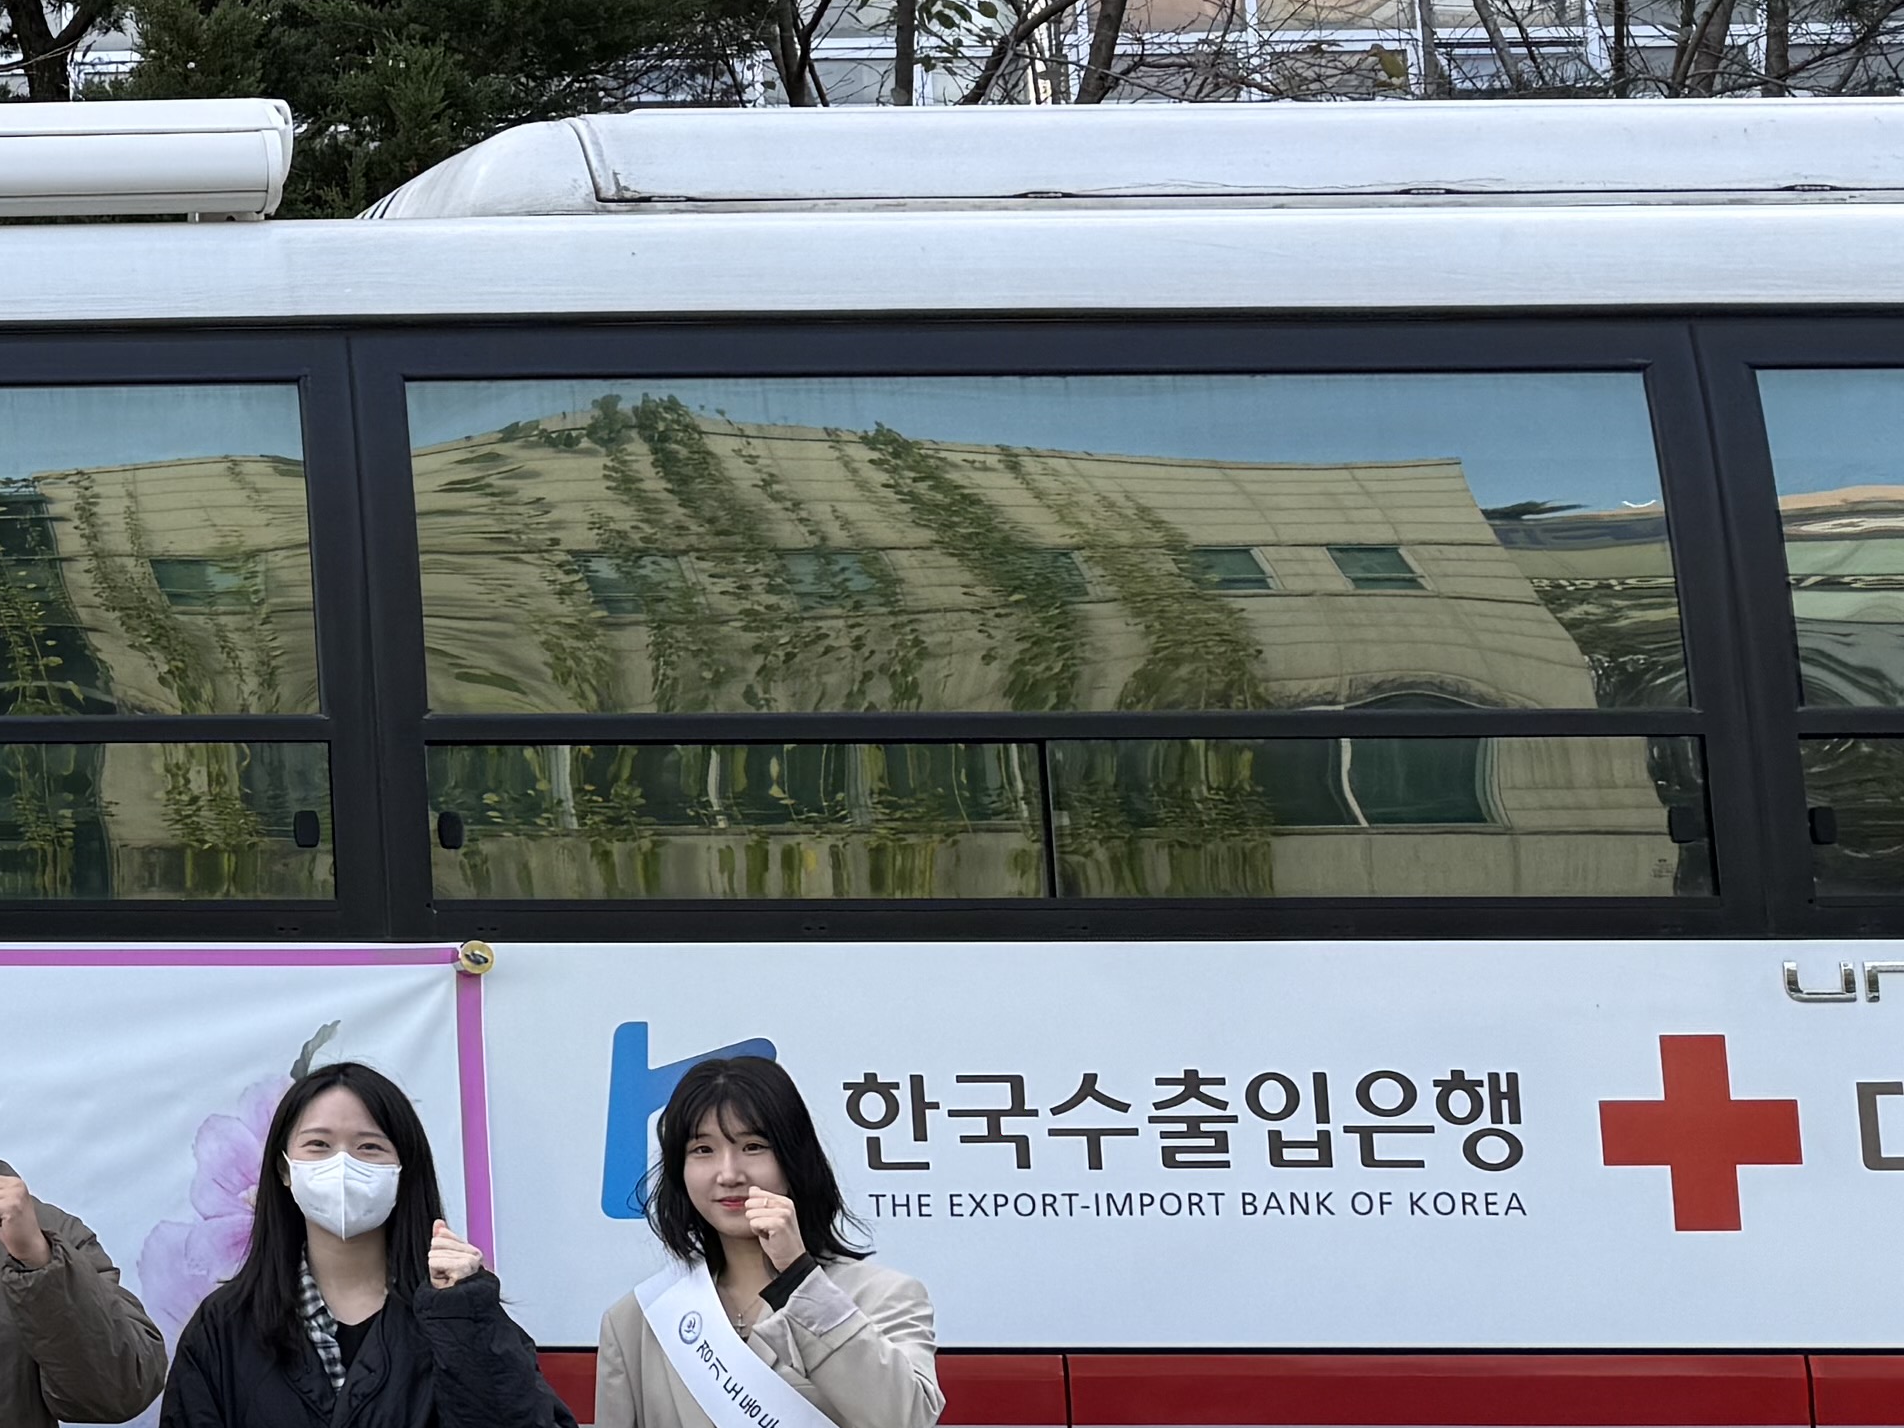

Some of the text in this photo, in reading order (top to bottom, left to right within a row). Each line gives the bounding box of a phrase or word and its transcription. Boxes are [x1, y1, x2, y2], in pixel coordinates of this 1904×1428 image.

[842, 1068, 1524, 1172] 한국수출입은행
[868, 1191, 1528, 1219] THE EXPORT-IMPORT BANK OF KOREA
